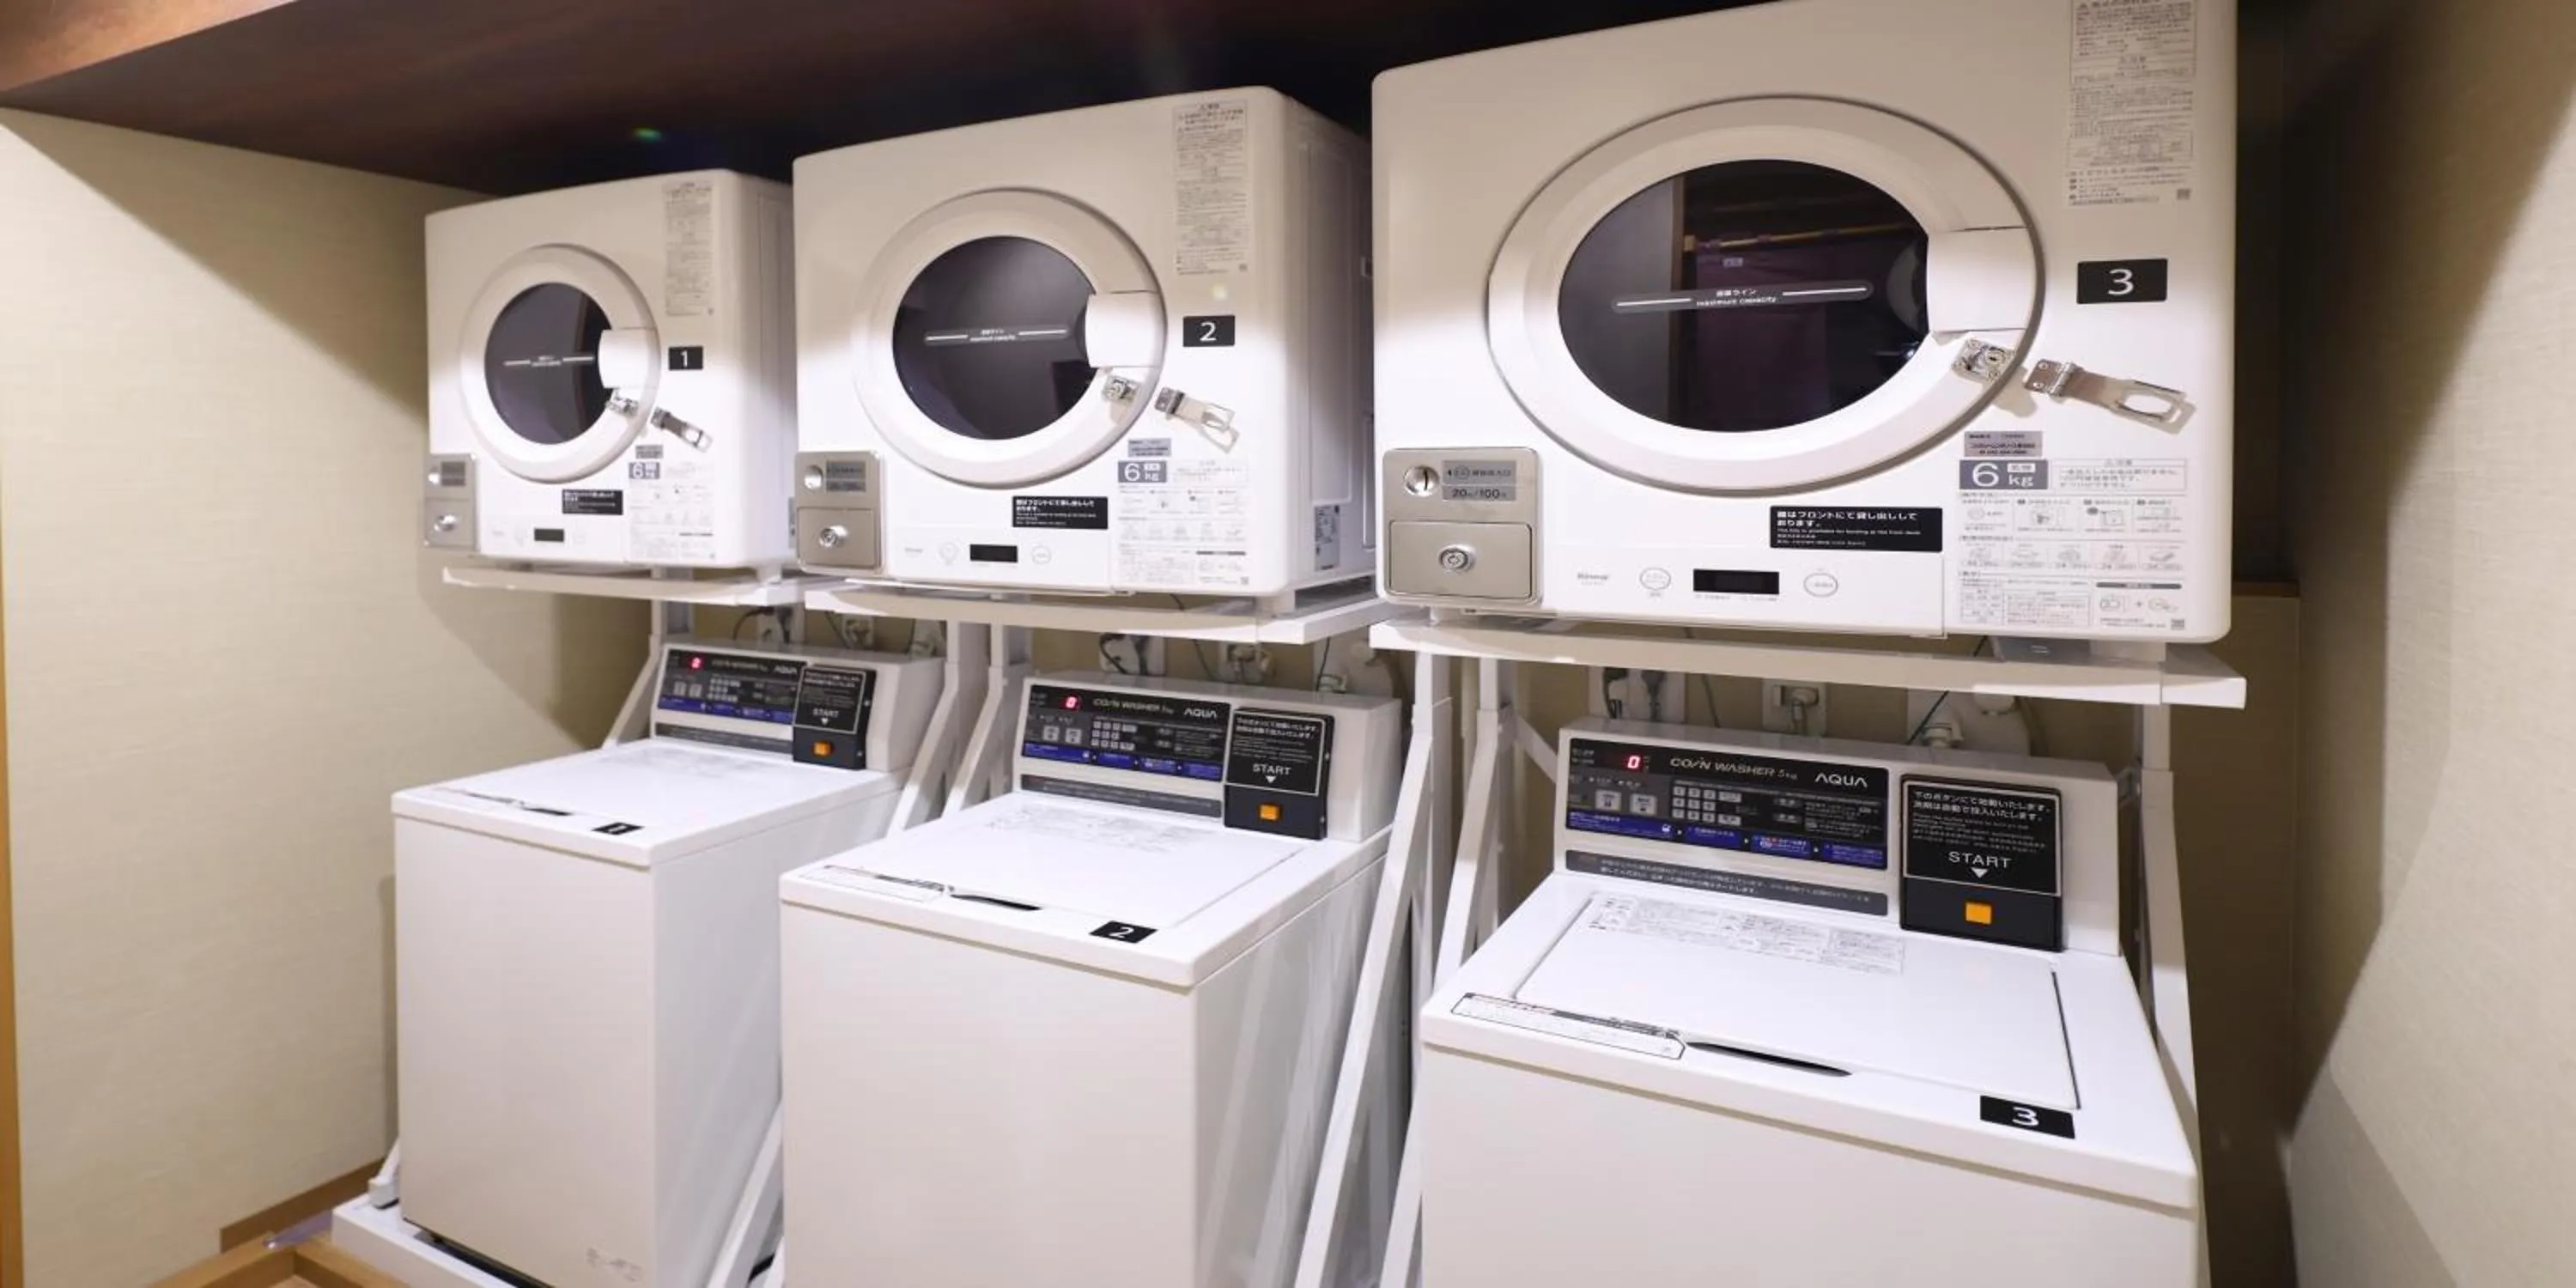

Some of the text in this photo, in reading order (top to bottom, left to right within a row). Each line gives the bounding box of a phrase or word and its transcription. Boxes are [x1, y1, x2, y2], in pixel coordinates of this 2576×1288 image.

[2108, 269, 2134, 295] 3
[1200, 322, 1217, 342] 2
[680, 350, 688, 368] 1
[1124, 464, 1140, 482] 6
[1972, 462, 2000, 488] 6
[2008, 474, 2034, 489] kg
[1184, 708, 1218, 720] AQUA
[1253, 763, 1291, 775] START
[1627, 755, 1642, 769] 0
[1670, 756, 1710, 770] COIN
[1715, 762, 1775, 777] WASHER
[1814, 771, 1868, 788] AQUA
[1948, 851, 2013, 868] START
[1109, 927, 1134, 939] 2
[2012, 1106, 2039, 1127] 3
